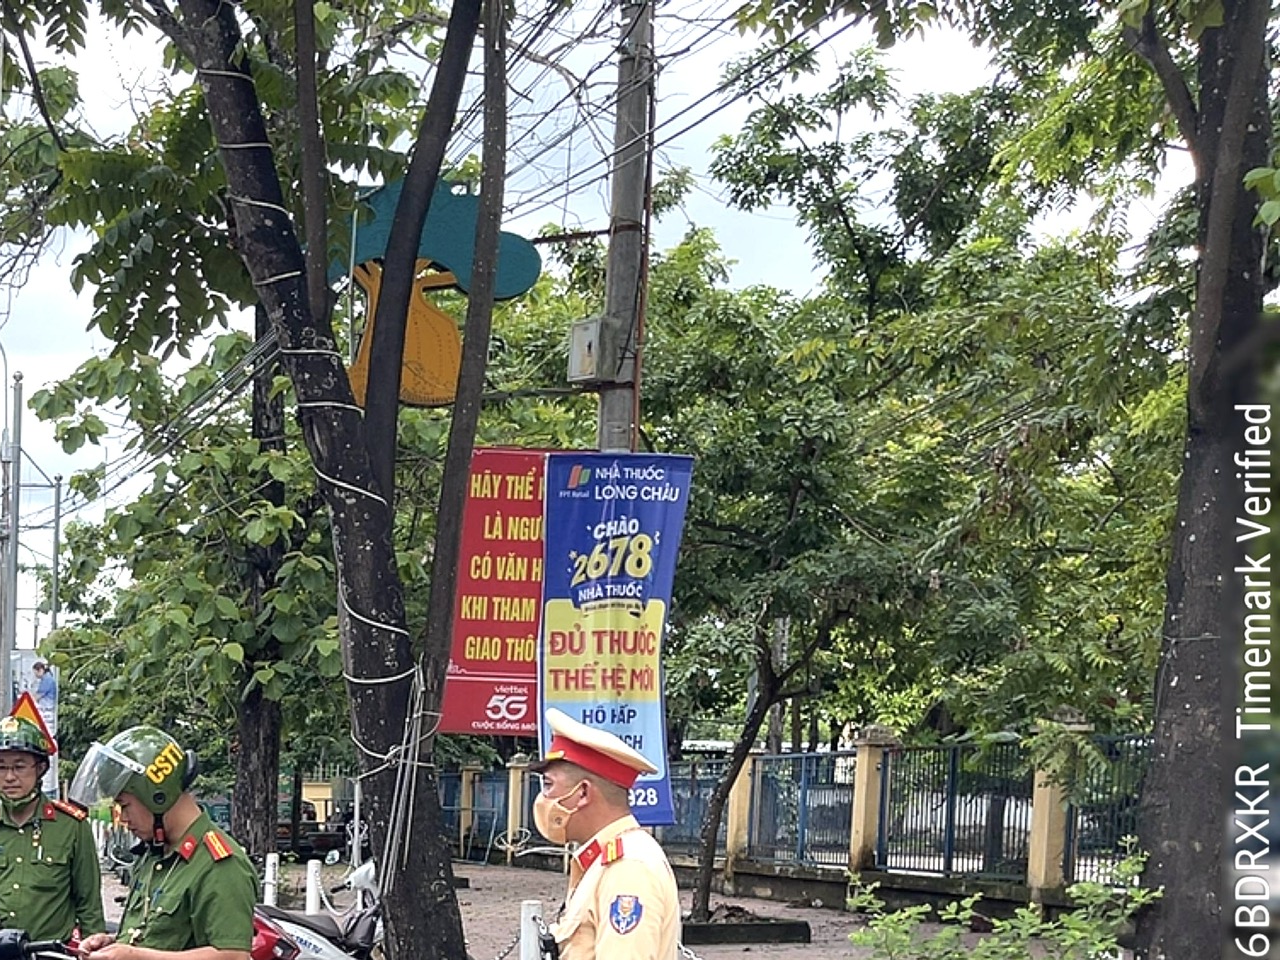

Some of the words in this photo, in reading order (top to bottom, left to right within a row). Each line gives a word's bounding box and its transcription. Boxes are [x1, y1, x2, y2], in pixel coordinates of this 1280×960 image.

[470, 469, 502, 499] HÃY
[506, 466, 537, 500] THỂ
[595, 465, 621, 479] NHÀ
[623, 464, 665, 480] THUỐC
[595, 485, 638, 500] LONG
[640, 482, 680, 502] CHÂU
[483, 510, 503, 539] LÀ
[507, 515, 544, 541] NGƯ
[593, 515, 639, 539] CHÀO
[470, 550, 492, 580] CÓ
[497, 552, 528, 581] VĂN
[570, 533, 653, 588] 2678
[578, 583, 604, 602] NHÀ
[605, 581, 643, 598] THUỐC
[461, 595, 488, 621] KHI
[492, 597, 536, 622] THAM
[465, 635, 502, 661] GIAO
[506, 634, 537, 662] THÔ
[549, 622, 586, 656] ĐỦ
[592, 623, 657, 656] THUỐC
[549, 660, 596, 691] THẾ
[601, 663, 627, 697] HỆ
[630, 664, 654, 692] MỚI
[485, 695, 529, 721] 5G
[582, 705, 607, 724] HÔ
